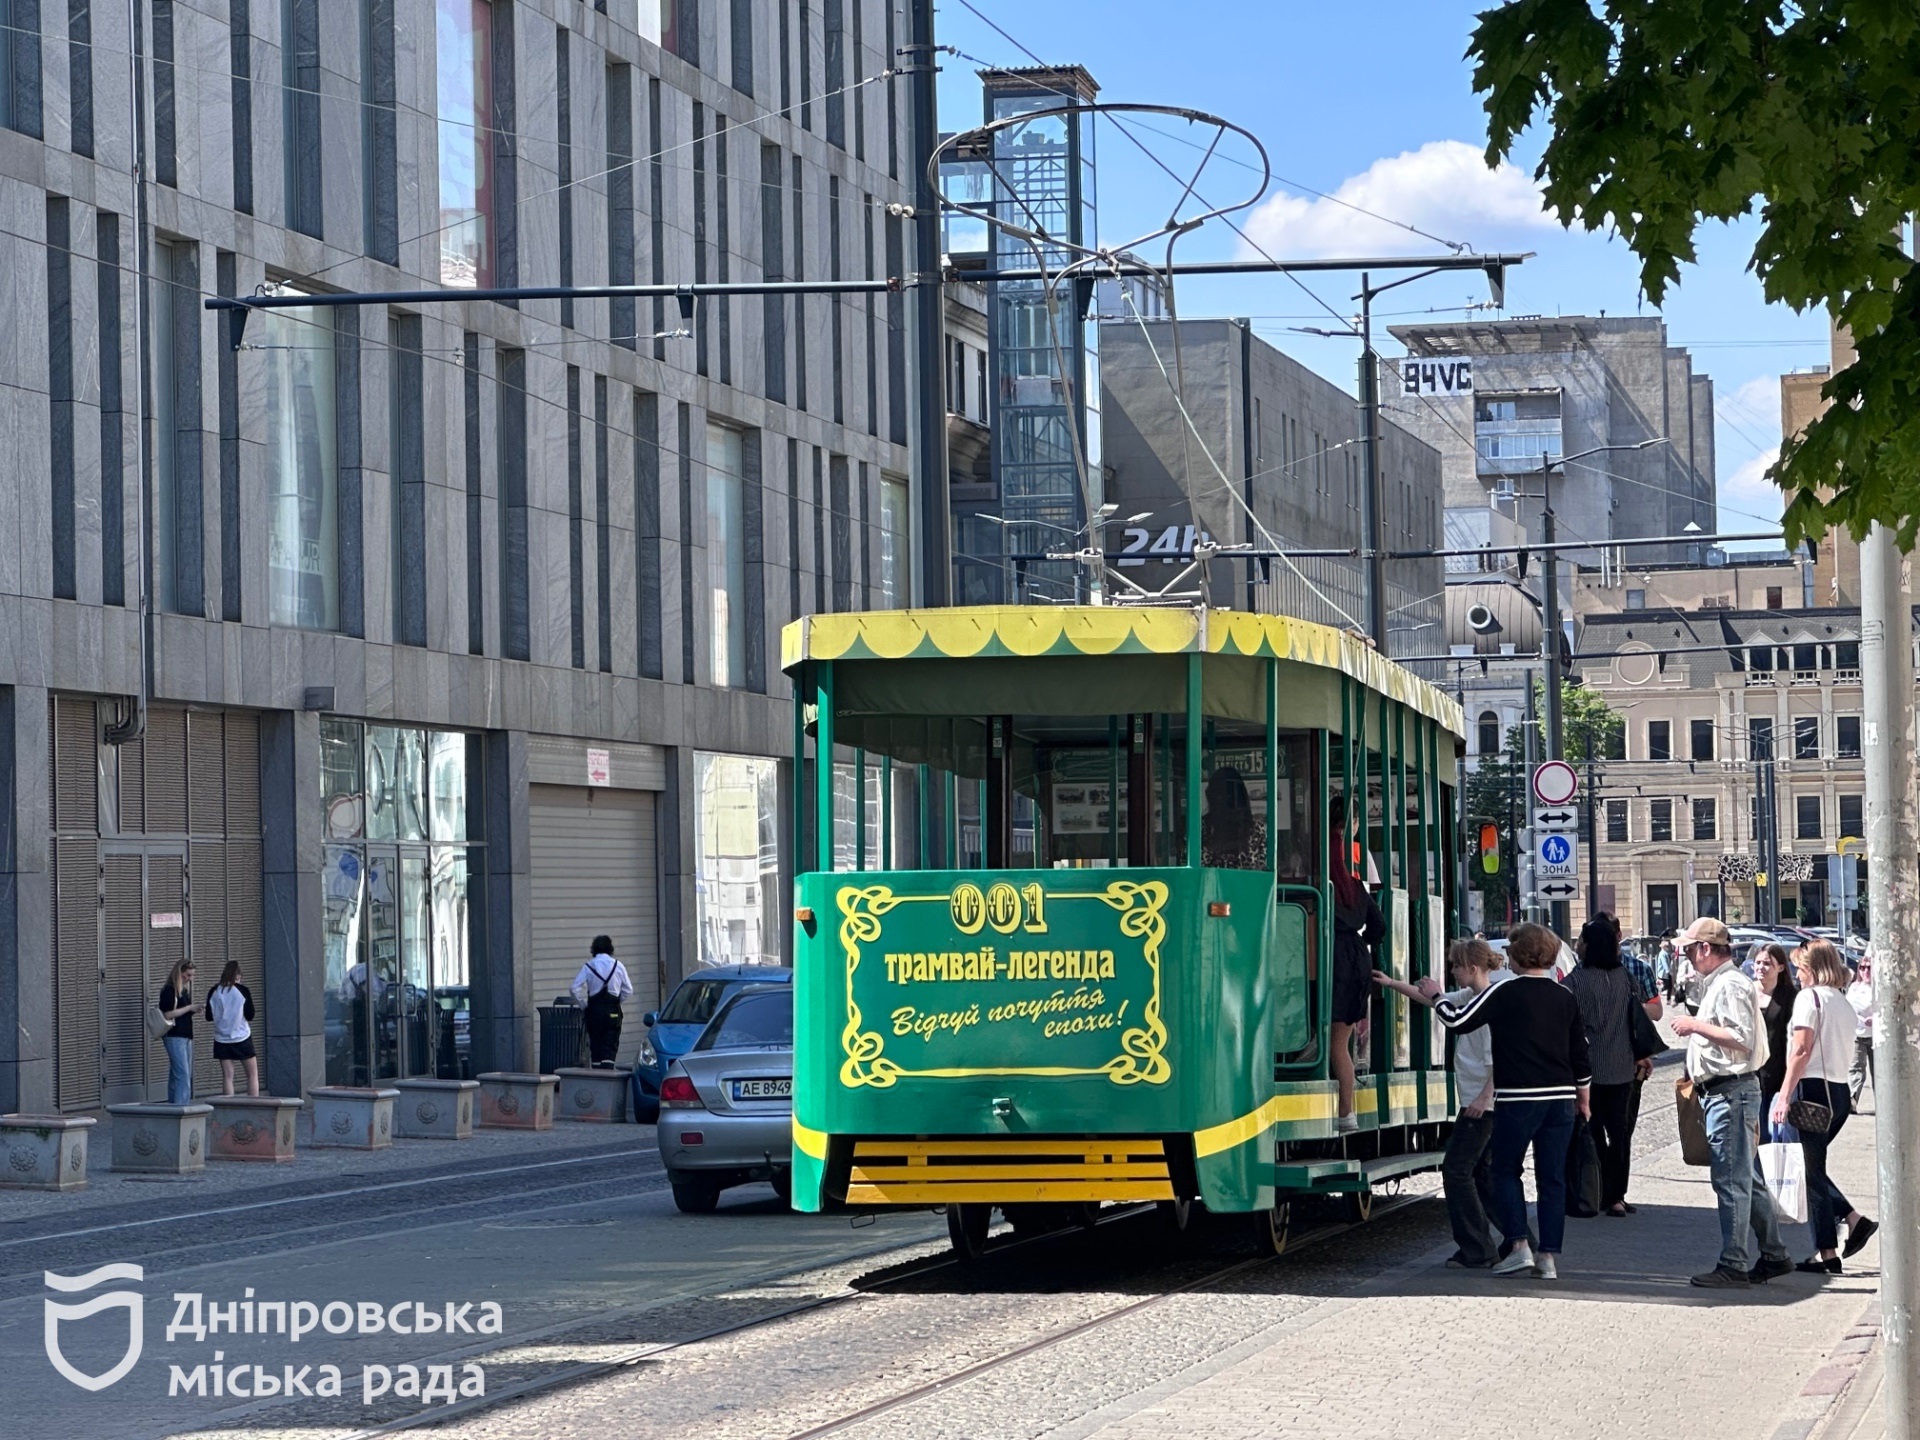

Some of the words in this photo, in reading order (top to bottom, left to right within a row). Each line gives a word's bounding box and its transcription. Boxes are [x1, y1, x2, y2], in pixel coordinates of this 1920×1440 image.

[1542, 864, 1571, 874] ЗОНА
[950, 882, 1048, 935] 001
[884, 946, 1115, 985] трамвай-легенда
[891, 1004, 980, 1042] Відчуй
[988, 986, 1106, 1023] почуття
[1044, 999, 1129, 1038] епохи!
[763, 1081, 791, 1095] 8949
